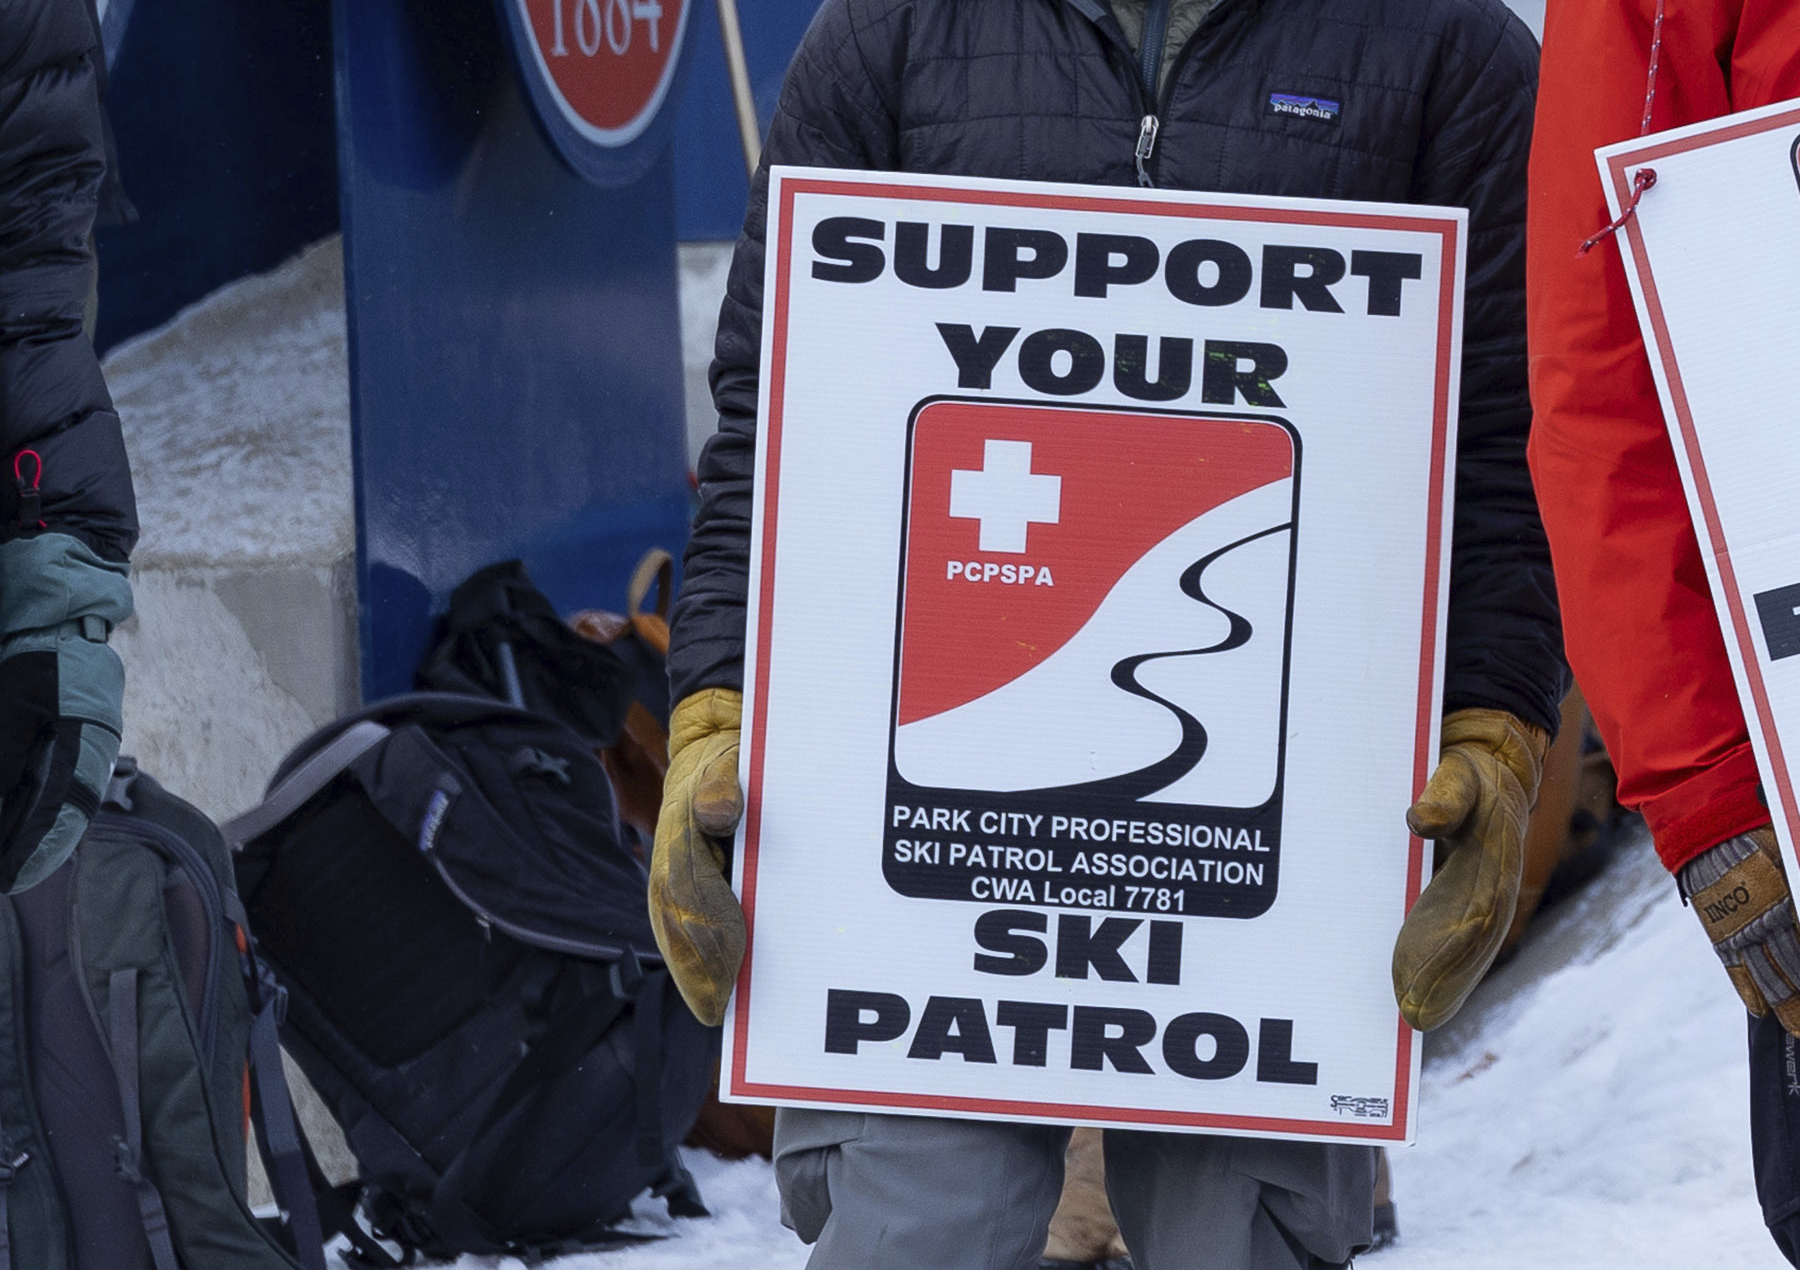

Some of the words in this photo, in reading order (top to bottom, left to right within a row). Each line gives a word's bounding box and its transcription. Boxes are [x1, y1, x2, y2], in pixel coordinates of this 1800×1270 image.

[1273, 103, 1331, 119] patagonia
[811, 216, 1422, 317] SUPPORT
[935, 322, 1288, 409] YOUR
[947, 561, 1054, 586] PCPSPA
[893, 805, 971, 832] PARK
[980, 812, 1043, 837] CITY
[1051, 816, 1270, 852] PROFESSIONAL
[894, 840, 940, 863] SKI
[950, 843, 1062, 873] PATROL
[1071, 852, 1264, 886] ASSOCIATION
[971, 877, 1035, 902] CWA
[1043, 881, 1115, 907] Local
[1124, 886, 1185, 912] 7781
[973, 909, 1184, 986] SKI
[824, 988, 1318, 1086] PATROL
